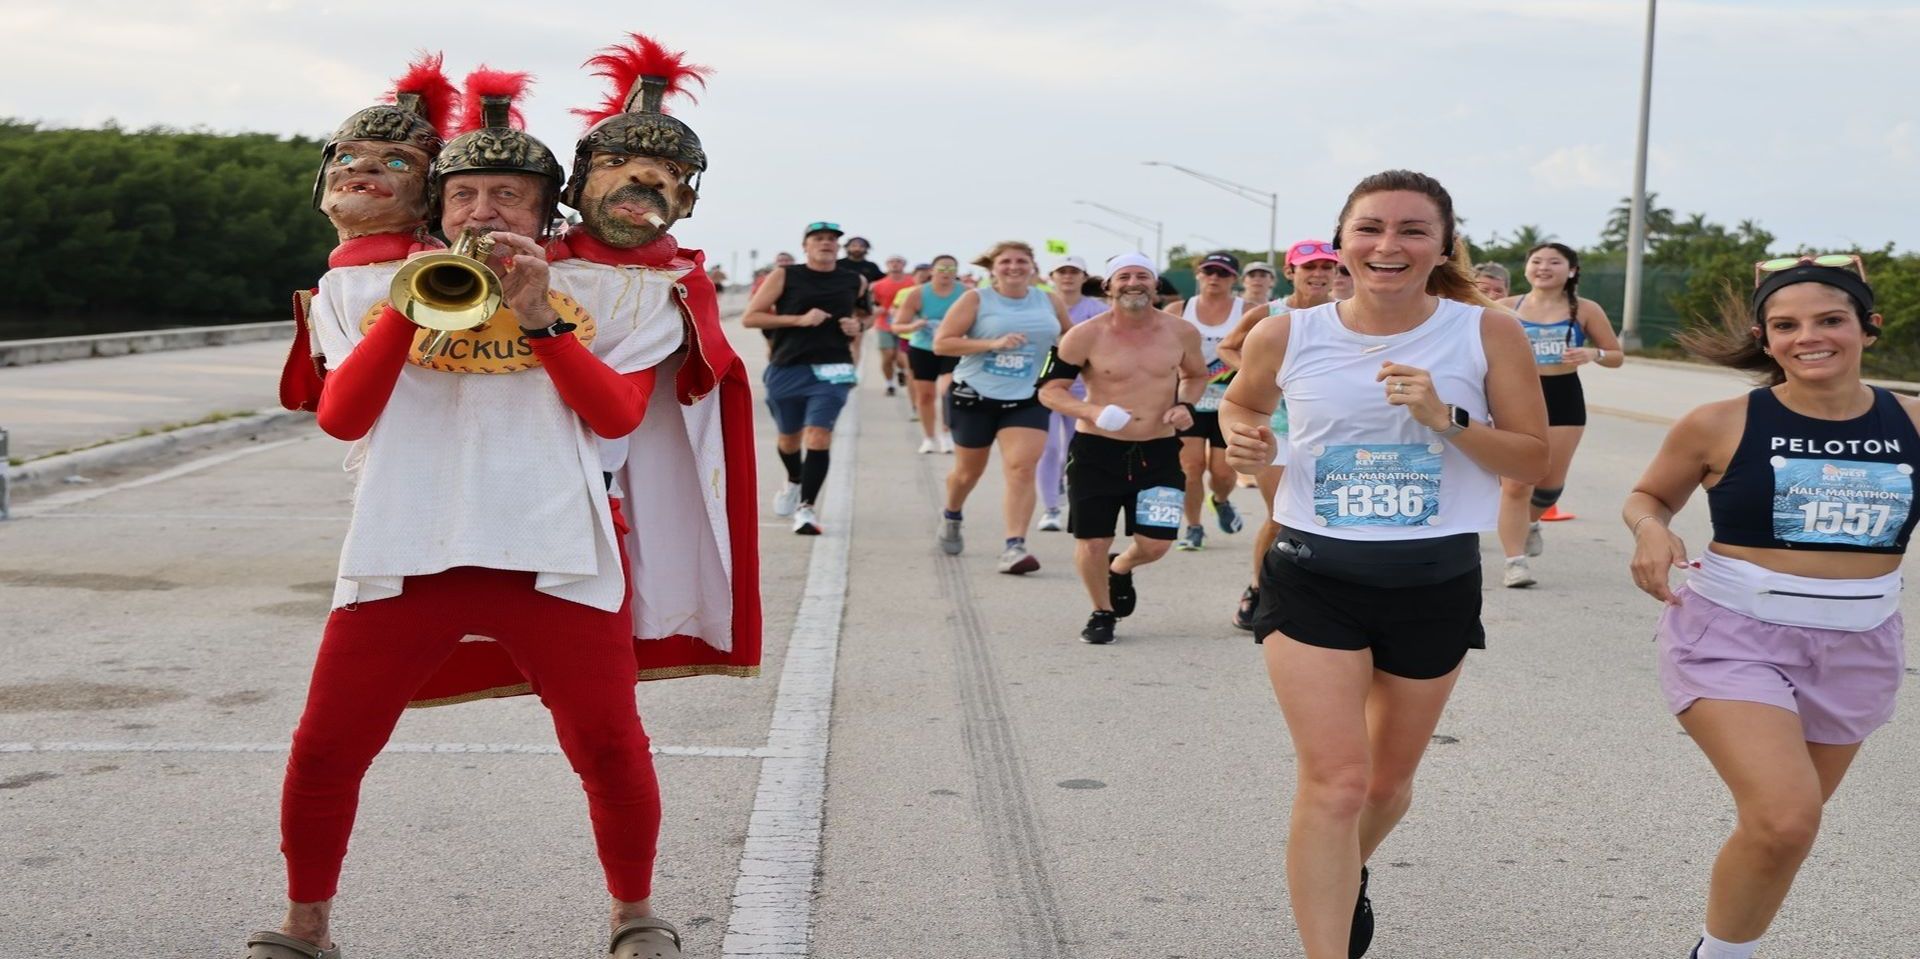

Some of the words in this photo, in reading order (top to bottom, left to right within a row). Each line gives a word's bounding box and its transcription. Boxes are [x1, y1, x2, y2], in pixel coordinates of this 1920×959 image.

[995, 354, 1025, 369] 938
[1771, 436, 1901, 455] PELOTON
[1326, 473, 1355, 481] HALF
[1358, 472, 1429, 481] MARATHON
[1331, 484, 1424, 517] 1336
[1789, 486, 1823, 496] HALF
[1825, 488, 1900, 500] MARATHON
[1148, 505, 1181, 524] 325
[1798, 501, 1891, 537] 1557
